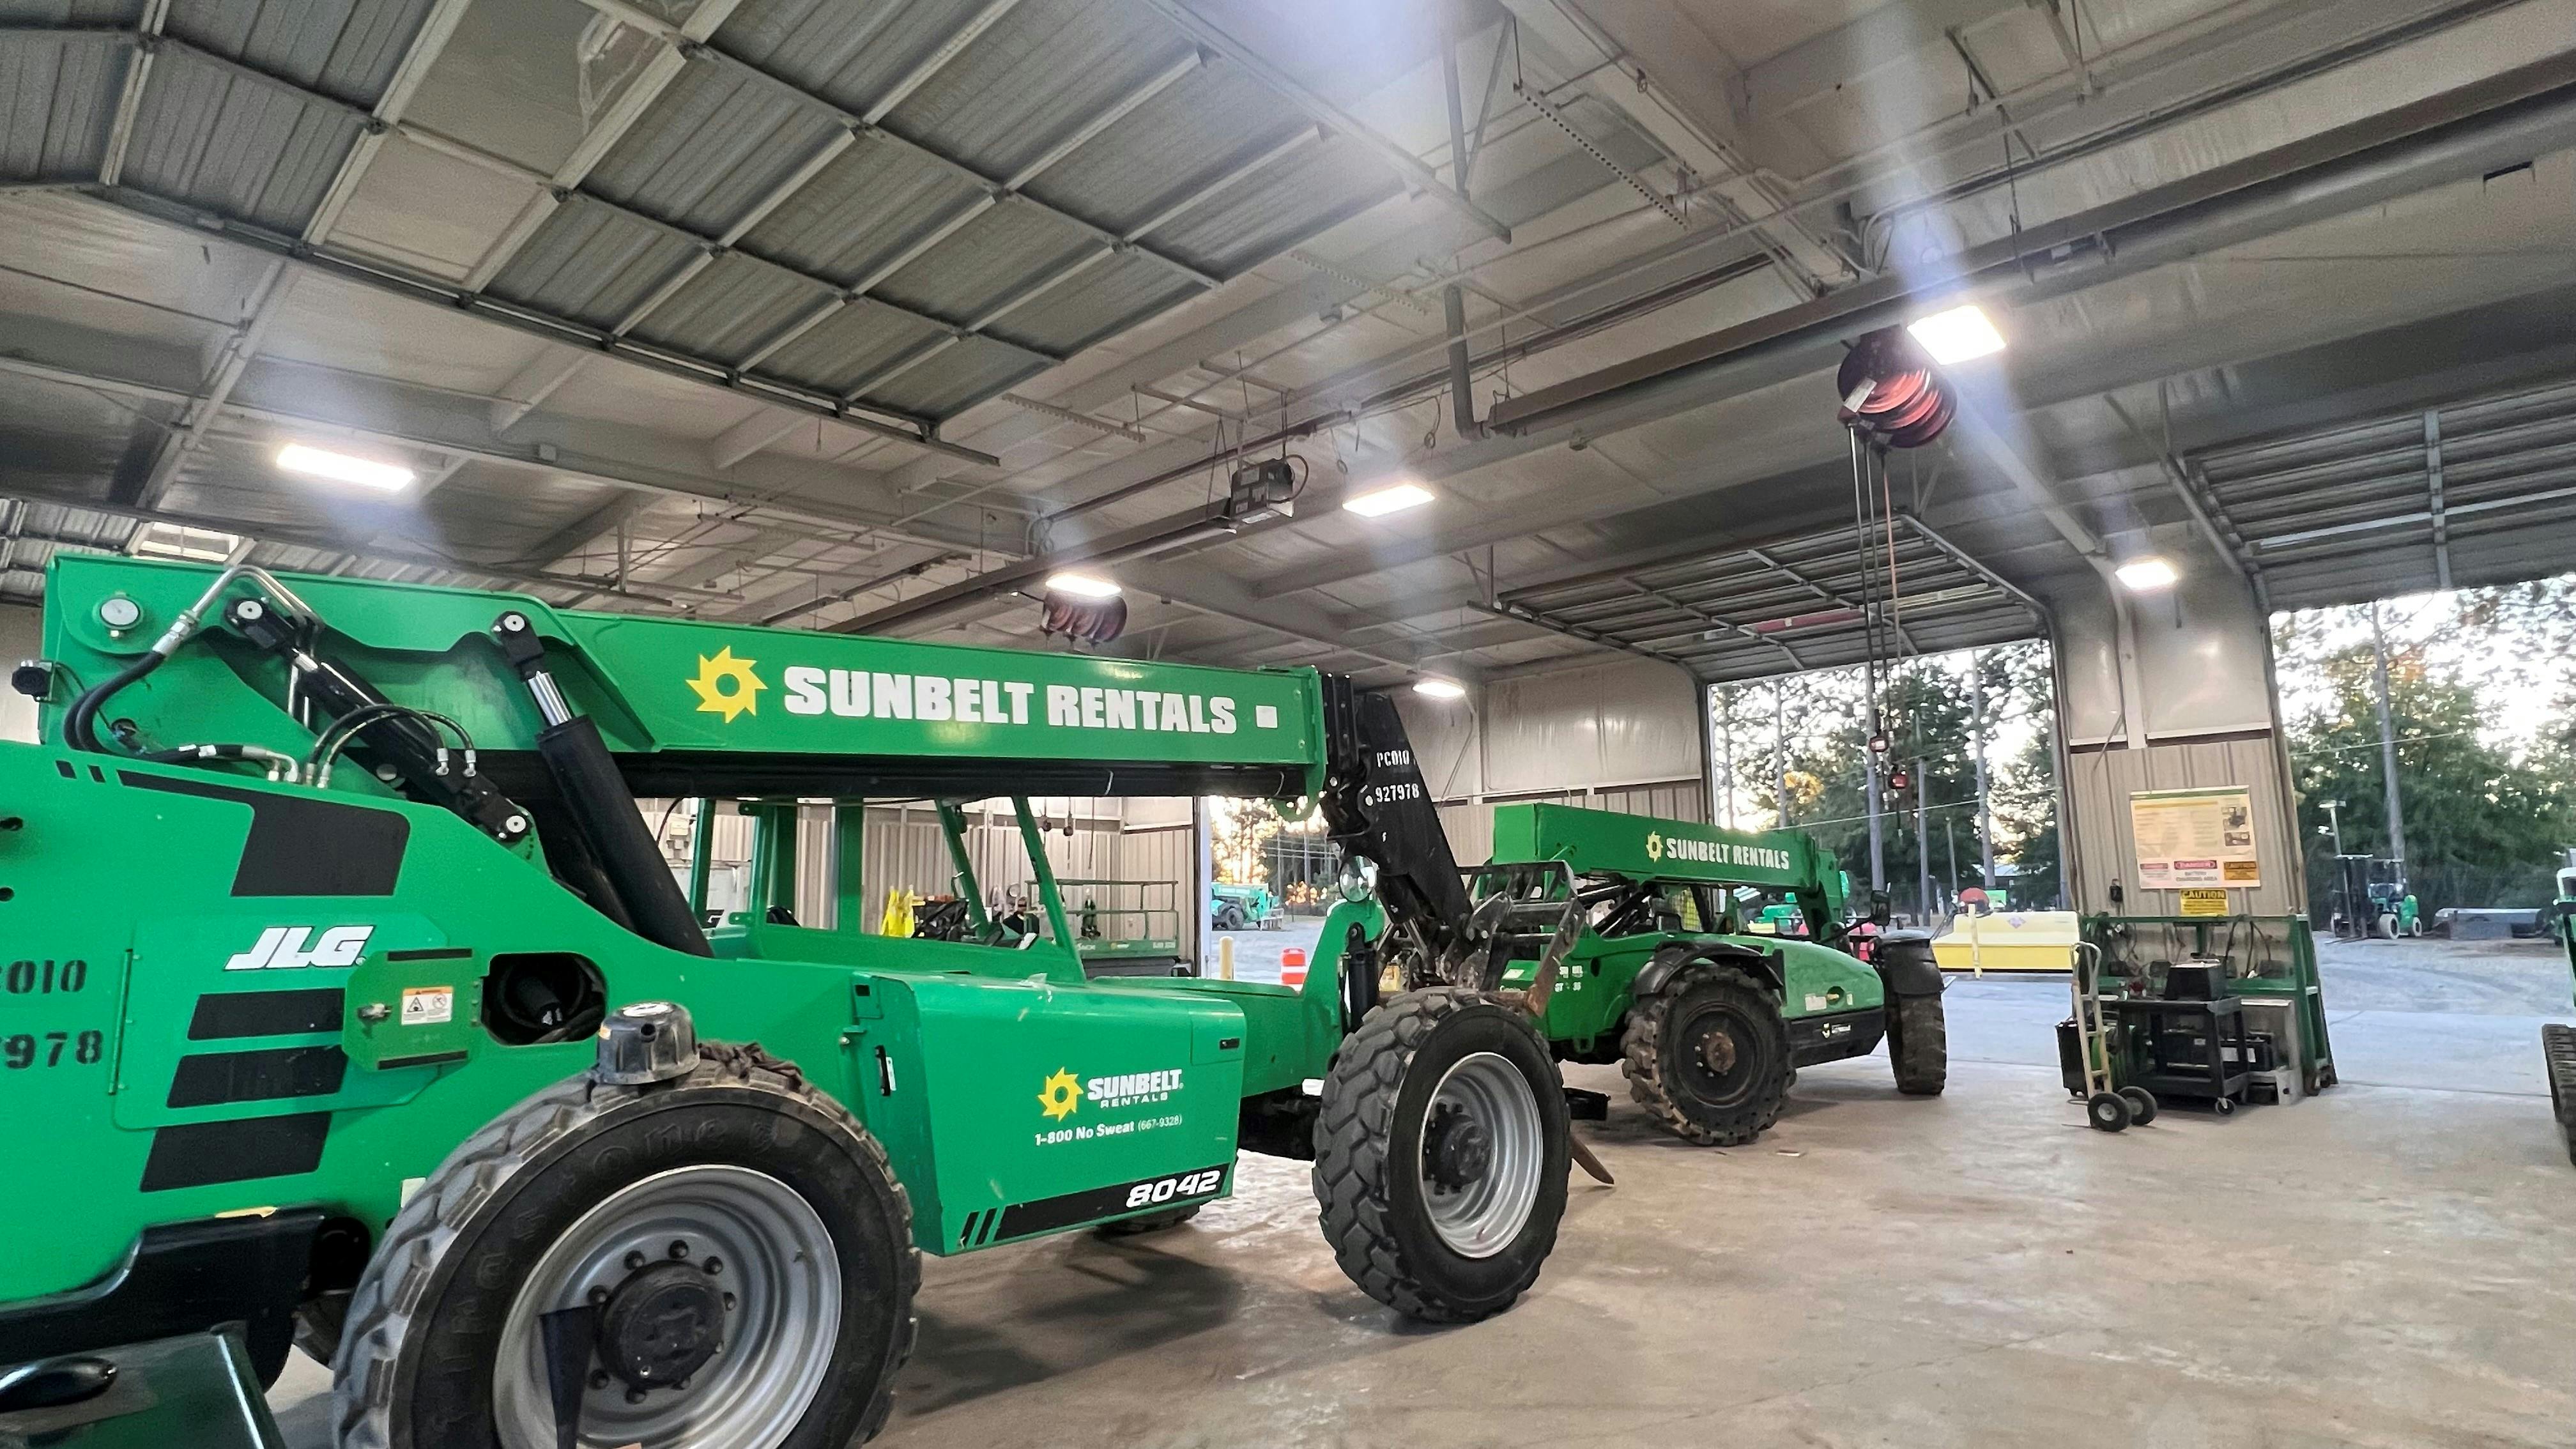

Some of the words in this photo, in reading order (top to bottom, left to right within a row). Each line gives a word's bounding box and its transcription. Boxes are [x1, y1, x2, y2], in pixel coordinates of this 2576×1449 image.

[783, 665, 1035, 724] SUNBELT
[1046, 684, 1238, 735] RENTALS
[1375, 783, 1420, 802] 927978
[1666, 838, 1729, 863] SUNBELT
[1733, 845, 1790, 870] RENTALS
[2182, 890, 2225, 899] CAUTION
[224, 925, 375, 970] JLG
[0, 960, 88, 993] 010
[0, 1030, 103, 1070] 978
[1087, 1069, 1182, 1100] SUNBELT
[1100, 1092, 1168, 1108] RENTALS
[1034, 1129, 1073, 1146] 1-800
[1076, 1126, 1094, 1140] No
[1096, 1121, 1135, 1137] Sweat
[1138, 1114, 1183, 1131] (667-9328)
[1126, 1170, 1221, 1208] 8042
